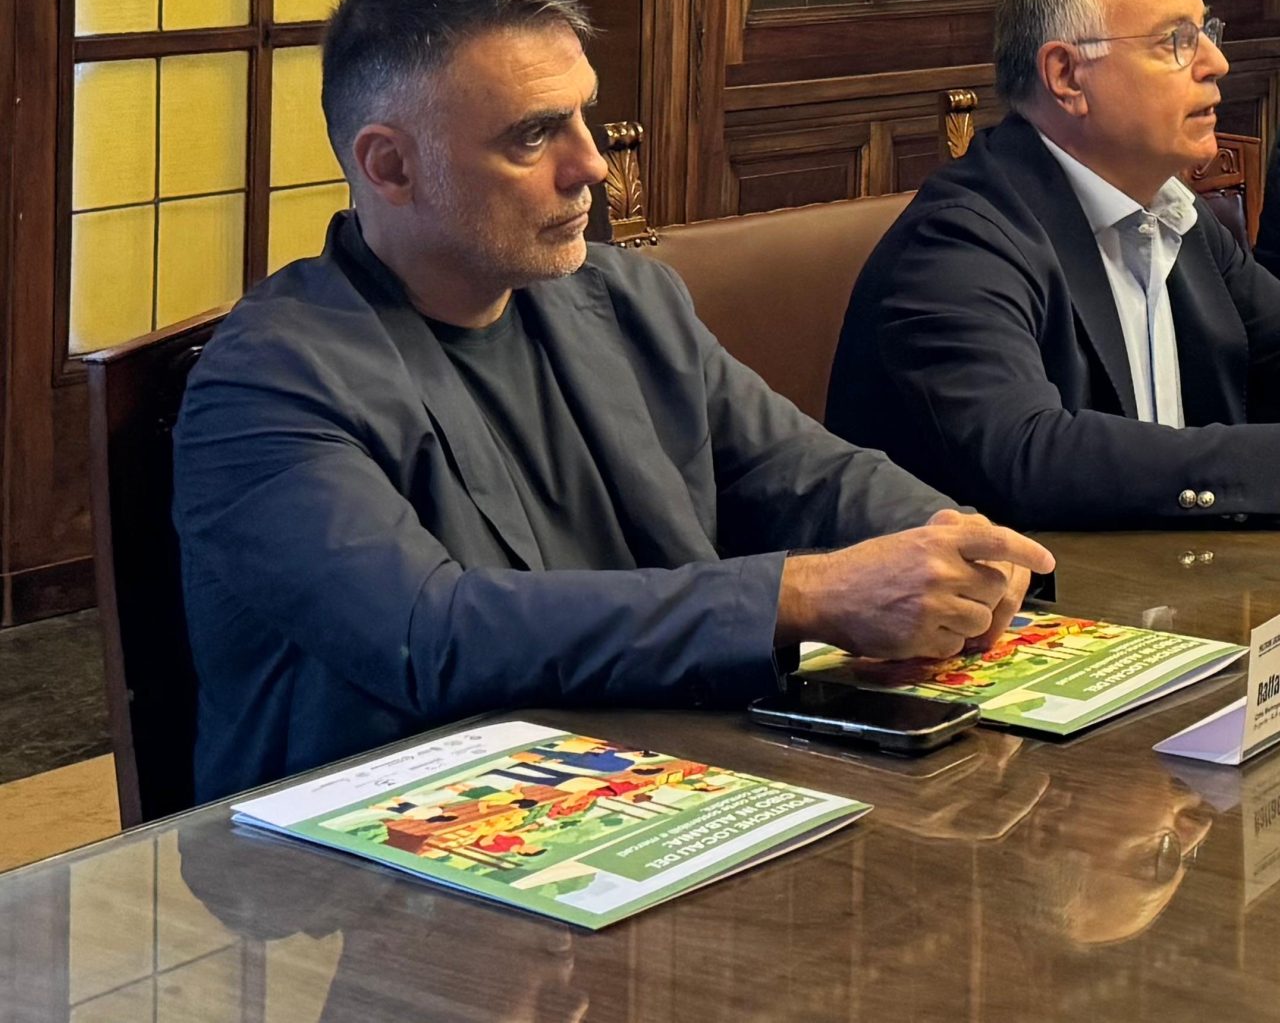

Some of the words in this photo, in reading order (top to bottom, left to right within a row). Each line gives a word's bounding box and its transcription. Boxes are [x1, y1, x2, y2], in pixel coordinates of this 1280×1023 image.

[736, 806, 756, 818] IN
[753, 792, 797, 809] CIBO
[734, 796, 817, 830] POLITICHE
[661, 813, 737, 849] ALBANIA:
[678, 827, 739, 857] LOCALI
[645, 854, 683, 869] DEL
